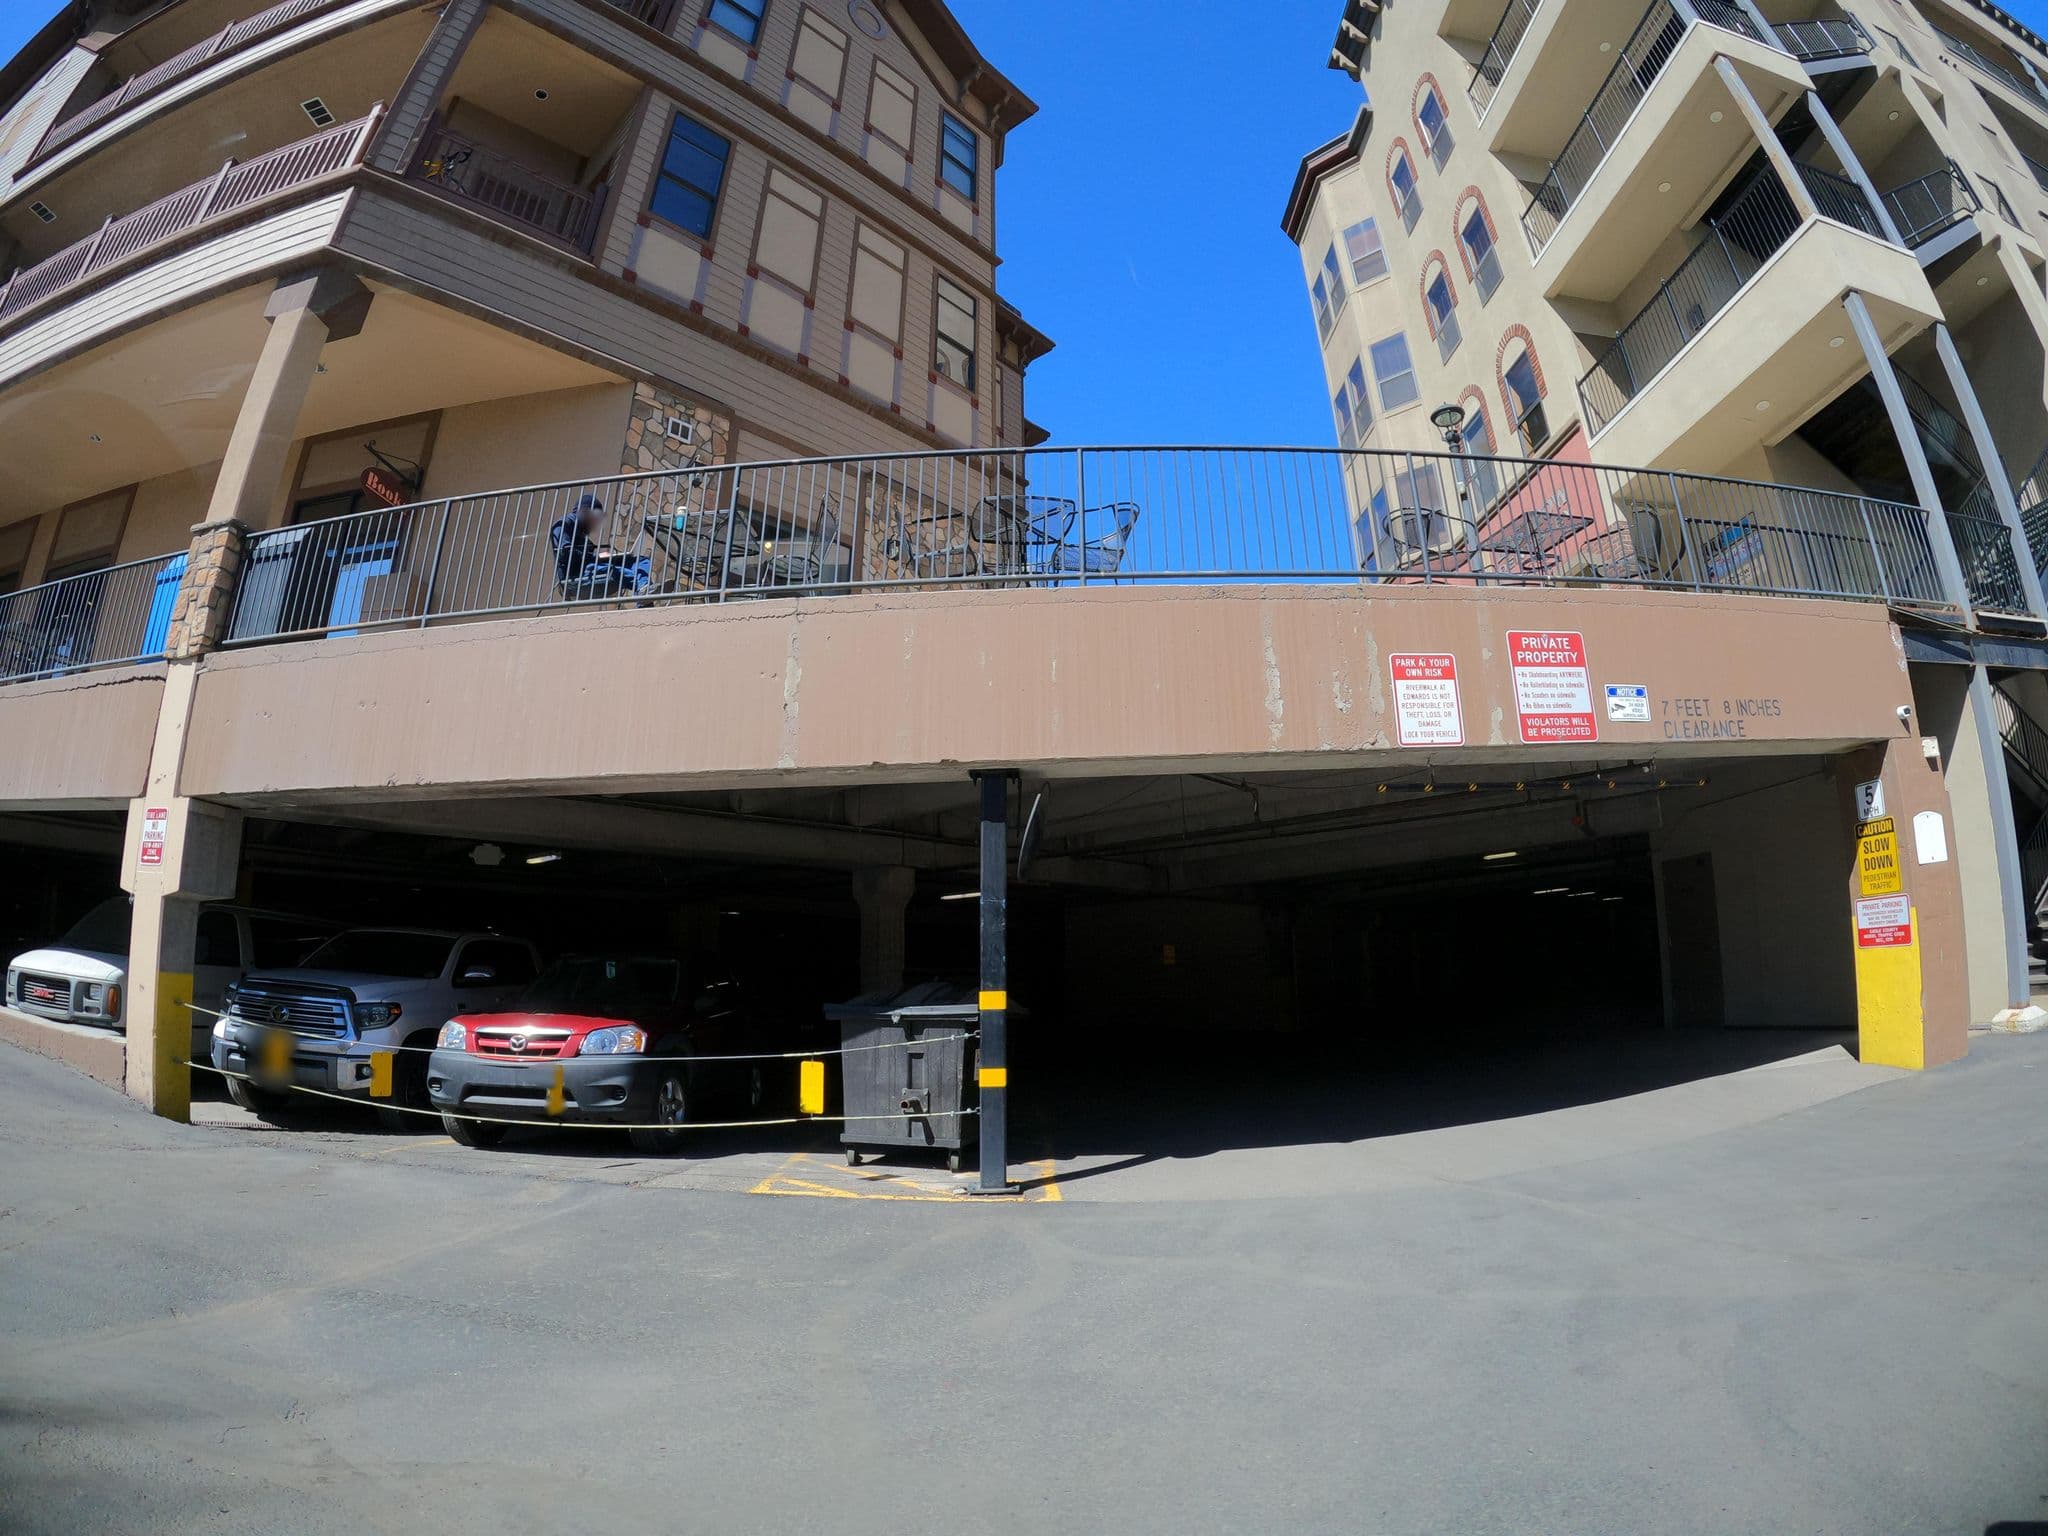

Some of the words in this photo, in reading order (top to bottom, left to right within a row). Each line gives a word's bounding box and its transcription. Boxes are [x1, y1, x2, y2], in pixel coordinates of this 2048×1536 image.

[1521, 637, 1571, 649] PRIVATE
[1395, 658, 1416, 666] PARK
[1418, 658, 1427, 666] AT
[1429, 658, 1450, 666] YOUR
[1517, 651, 1578, 663] PROPERTY
[1405, 668, 1423, 676] OWN
[1424, 668, 1443, 676] RISK
[1616, 687, 1637, 697] NOTICE
[1662, 701, 1668, 715] 7
[1676, 699, 1711, 717] FEET
[1724, 701, 1731, 714] 8
[1736, 699, 1781, 716] INCHES
[1526, 718, 1570, 726] VIOLATORS
[1571, 718, 1590, 726] WILL
[1527, 728, 1538, 736] BE
[1541, 727, 1591, 736] PROSECUTED
[1663, 720, 1747, 739] CLEARANCE
[1864, 786, 1874, 805] 5
[1864, 806, 1879, 816] MPH
[152, 822, 158, 830] NO
[1858, 819, 1892, 838] CAUTION
[144, 831, 164, 840] PARKING
[1863, 838, 1890, 854] SLOW
[1864, 854, 1893, 872] DOWN
[1864, 872, 1897, 882] PEDESTRIAN
[1870, 882, 1892, 890] TRAFFIC
[1882, 900, 1903, 908] PARKING
